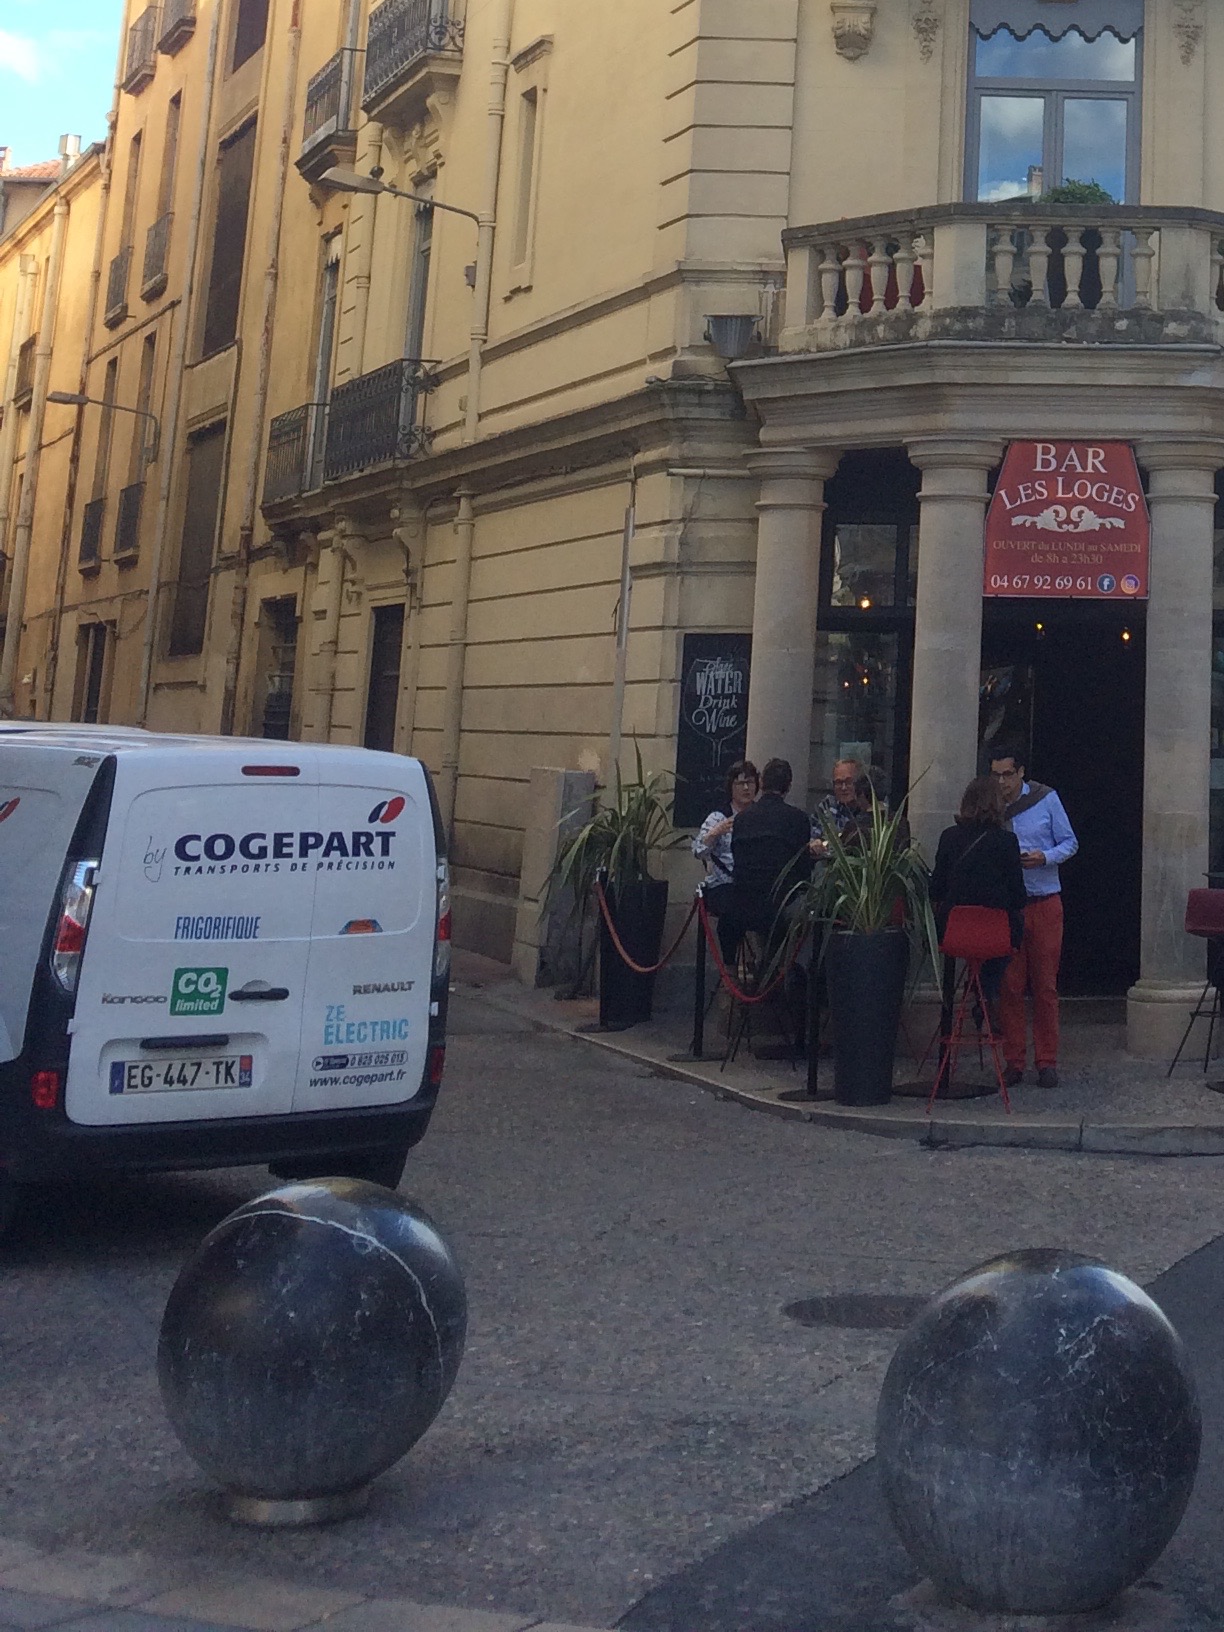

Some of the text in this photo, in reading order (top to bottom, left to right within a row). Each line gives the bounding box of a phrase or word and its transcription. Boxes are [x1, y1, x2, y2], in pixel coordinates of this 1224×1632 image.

[1033, 443, 1108, 474] BAR
[998, 476, 1139, 512] LES LOGES
[993, 540, 1141, 553] OUVERT du LUNDI au SAMEDI
[1031, 553, 1043, 564] de
[1045, 553, 1060, 564] 8h
[1070, 553, 1103, 565] 23h30
[990, 574, 1092, 590] 04 67 92 69 61
[696, 670, 743, 696] WATER
[699, 694, 738, 709] Drink
[692, 708, 737, 733] Wine
[174, 831, 396, 862] COGEPART
[143, 836, 167, 883] by
[174, 860, 396, 876] TRANSPORTS DE PRÉCISION
[174, 917, 261, 940] FRIGORIFIQUE
[352, 981, 415, 995] RENAULT
[175, 999, 219, 1011] limited
[324, 1019, 409, 1045] ELECTRIC
[127, 1060, 236, 1089] EG-447-TK
[309, 1069, 407, 1087] www.cogepart.fr
